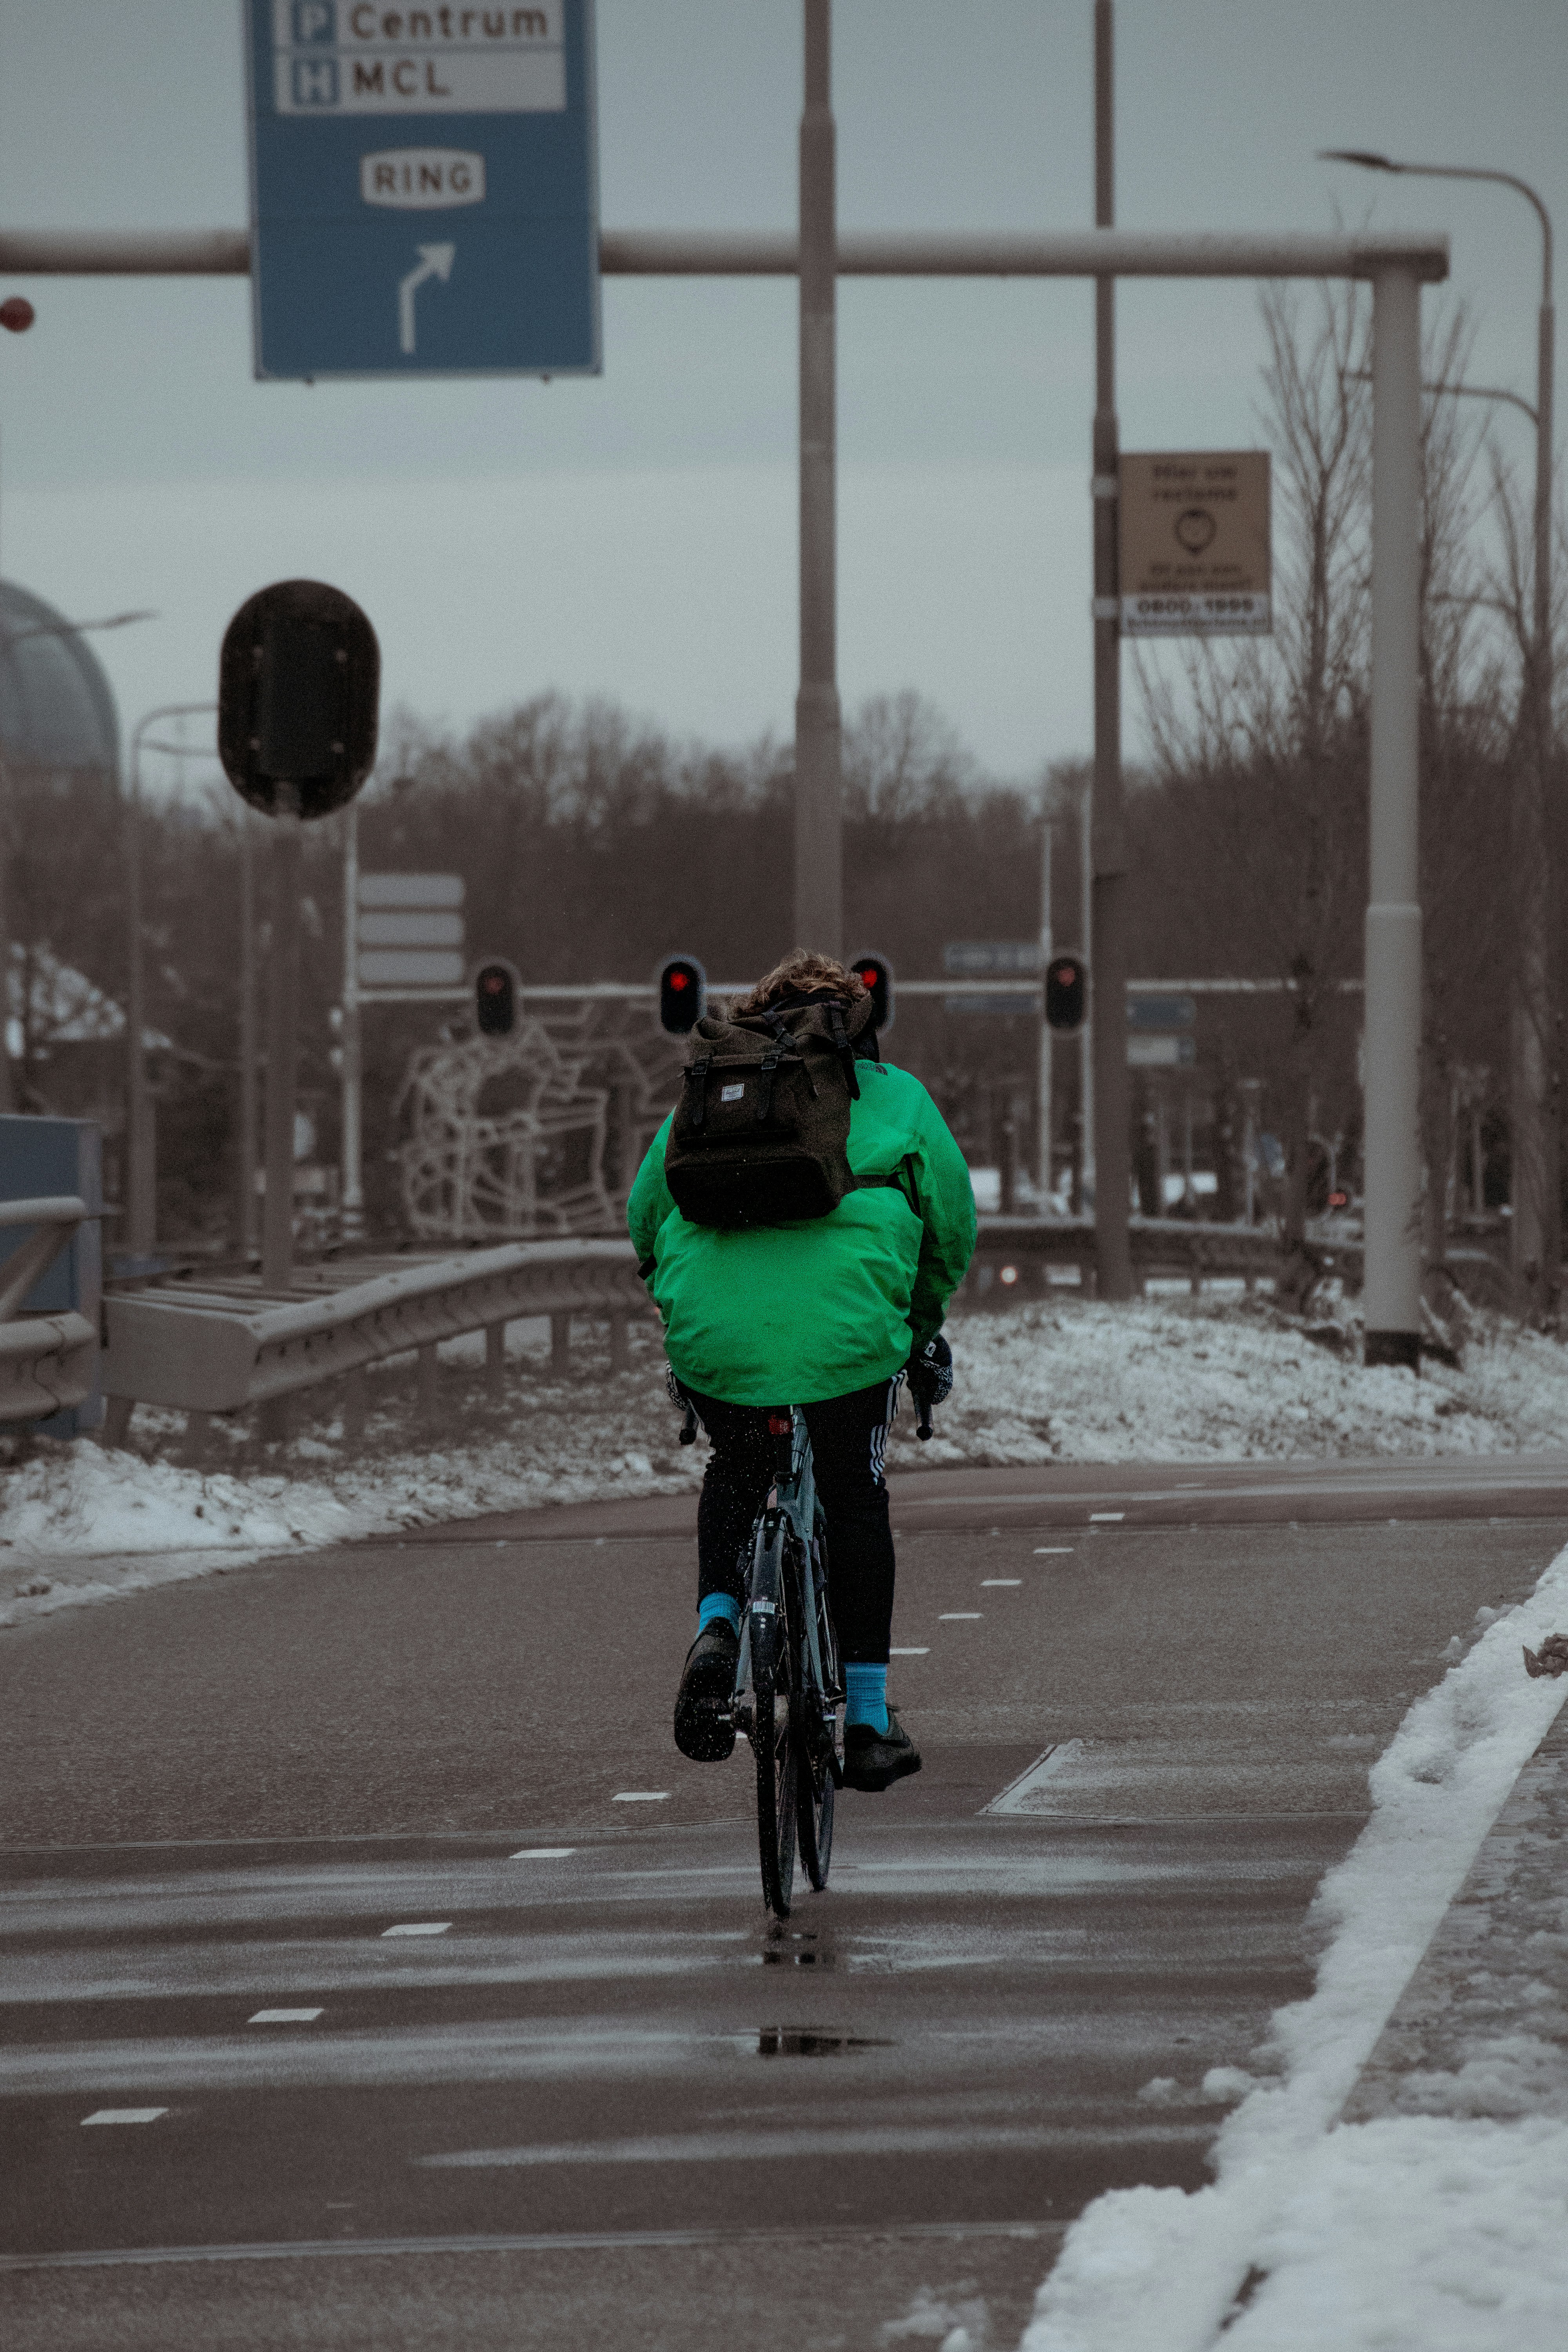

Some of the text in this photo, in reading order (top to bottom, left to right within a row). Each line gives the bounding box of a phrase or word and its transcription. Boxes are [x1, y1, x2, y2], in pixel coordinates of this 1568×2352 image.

[299, 4, 548, 38] P Centrum
[299, 61, 450, 101] H MCL
[374, 162, 472, 193] RING
